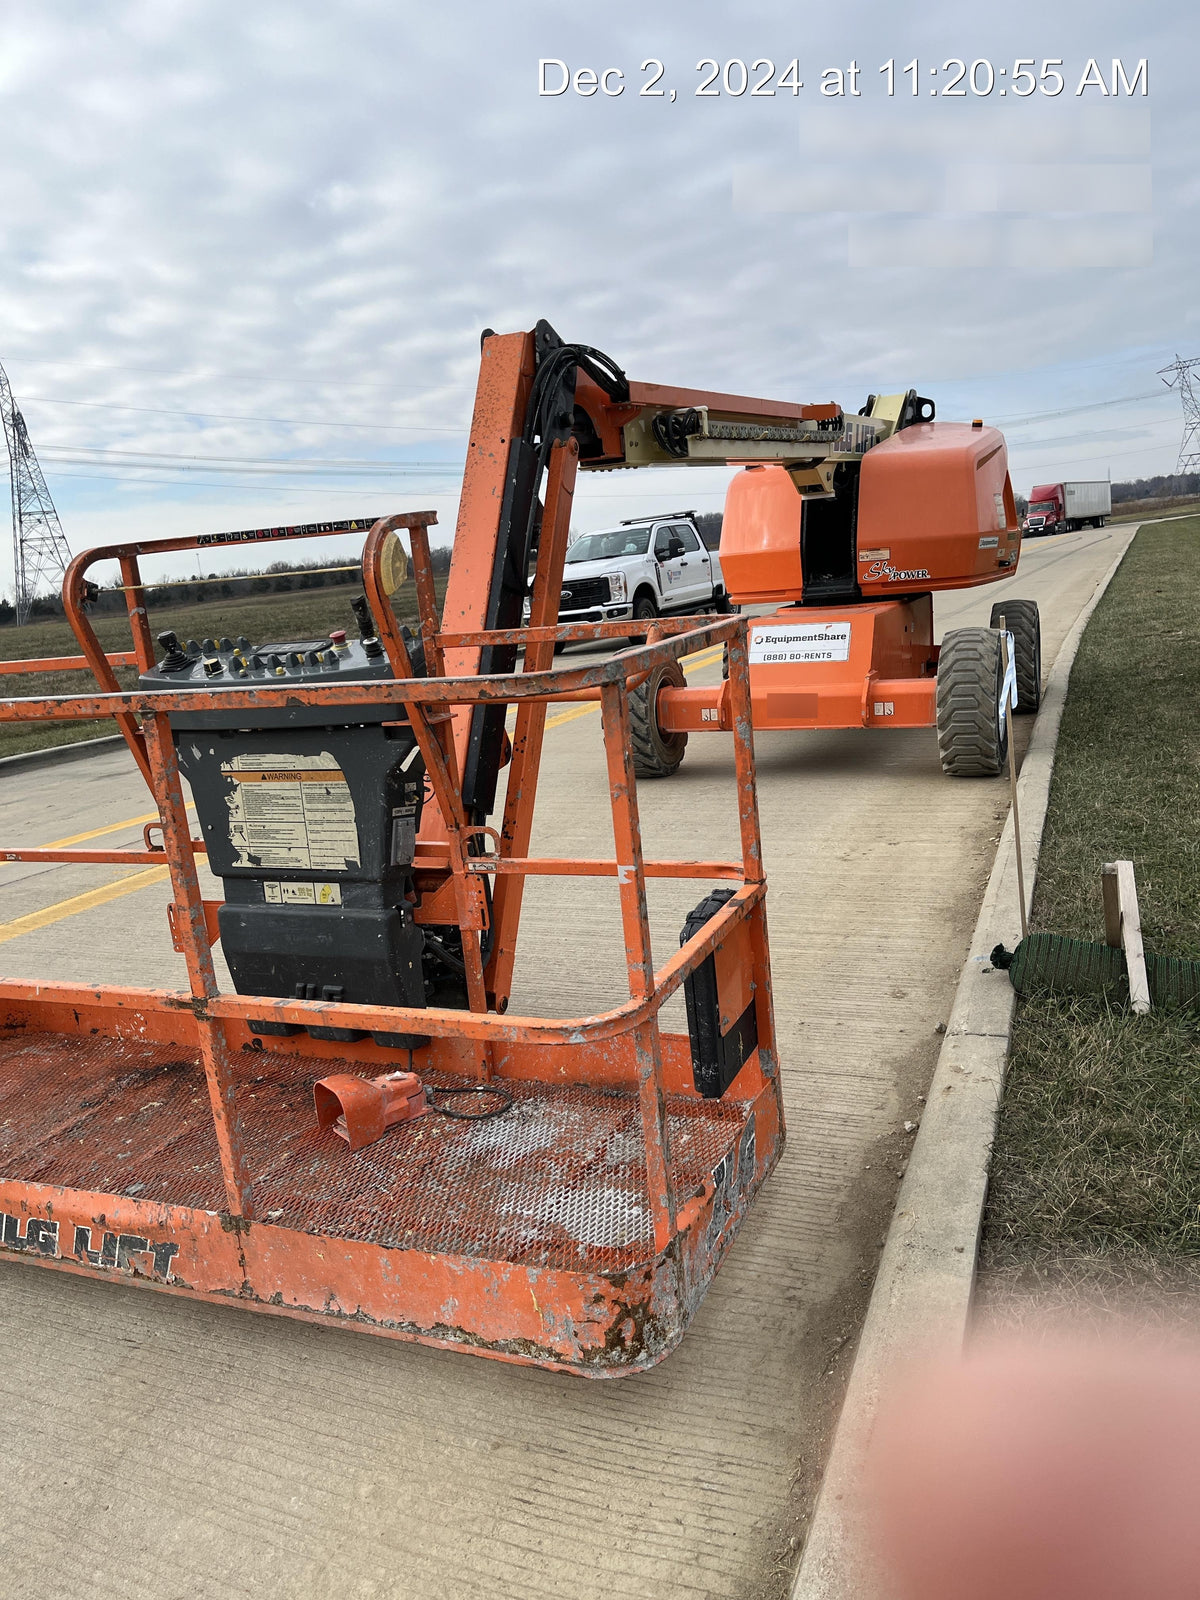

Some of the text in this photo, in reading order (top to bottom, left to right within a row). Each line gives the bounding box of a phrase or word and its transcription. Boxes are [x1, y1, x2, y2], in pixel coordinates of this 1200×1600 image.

[764, 633, 847, 645] EquipmentShare
[763, 652, 833, 661] (888) 80-RENTS
[267, 772, 303, 781] WARNING
[0, 1211, 180, 1280] LG LIFT
